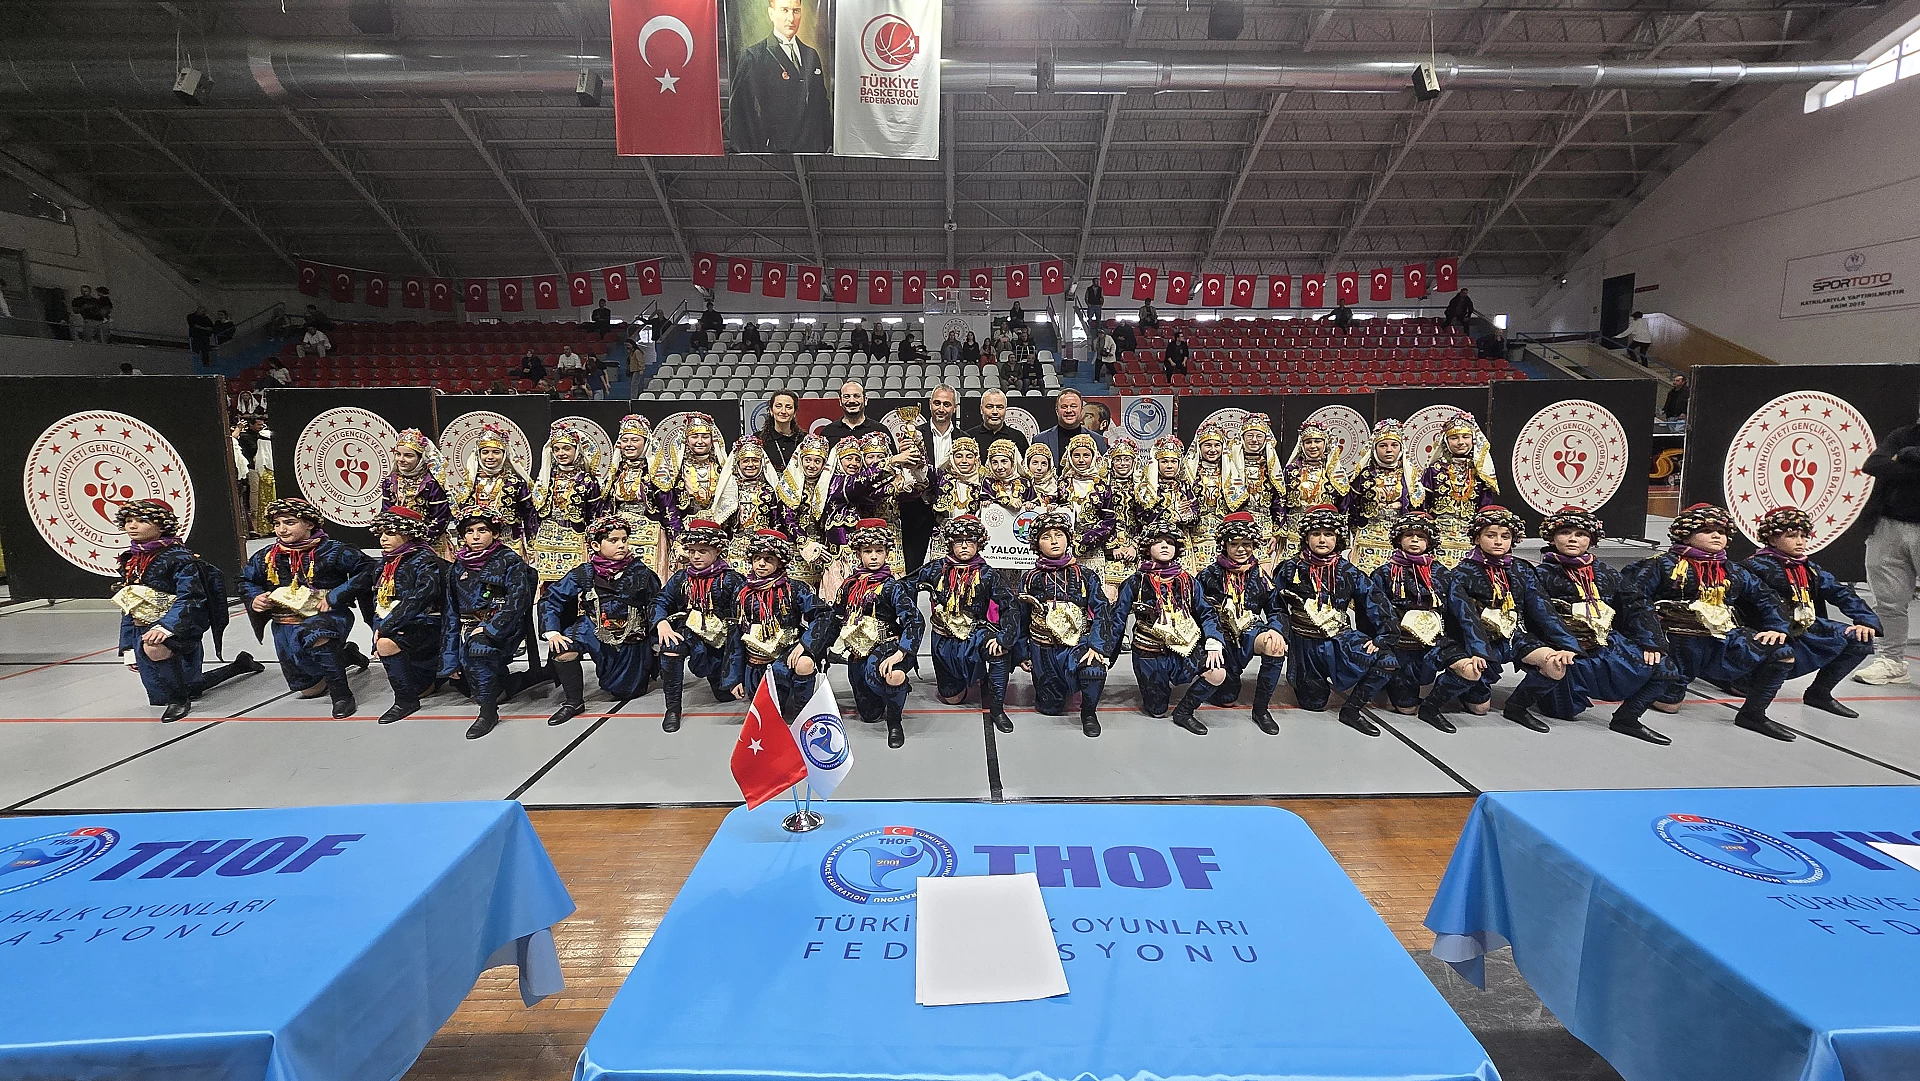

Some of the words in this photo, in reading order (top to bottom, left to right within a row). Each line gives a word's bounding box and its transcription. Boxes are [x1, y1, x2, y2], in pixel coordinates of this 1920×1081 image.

[860, 74, 919, 90] TÜRKİYE
[860, 87, 919, 99] BASKETBOL
[860, 96, 919, 106] FEDERASYONU
[1812, 272, 1892, 292] SPORTOTO
[1791, 422, 1827, 436] GENÇLİK
[340, 431, 371, 443] GENÇLİK
[370, 440, 379, 450] VE
[1562, 422, 1593, 434] GENÇLİK
[1592, 431, 1600, 441] VE
[1597, 440, 1606, 461] SPOR
[1825, 433, 1836, 447] VE
[88, 443, 133, 460] GENÇLİK
[1830, 446, 1842, 473] SPOR
[133, 455, 146, 469] VE
[56, 446, 87, 511] CUMHURİYETİ
[143, 468, 161, 496] SPOR
[1808, 476, 1840, 520] BAKANLIĞ
[66, 512, 105, 544] TÜRKİYE
[990, 545, 1029, 555] YALOVA
[89, 833, 367, 882] THOF
[973, 844, 1221, 890] THOF
[873, 891, 917, 903] RASYONU
[0, 906, 103, 923] HALK
[101, 898, 277, 921] OYUNLARI
[813, 913, 917, 932] TÜRKİ
[1072, 917, 1249, 936] OYUNLARI
[0, 921, 244, 946] ASYONU
